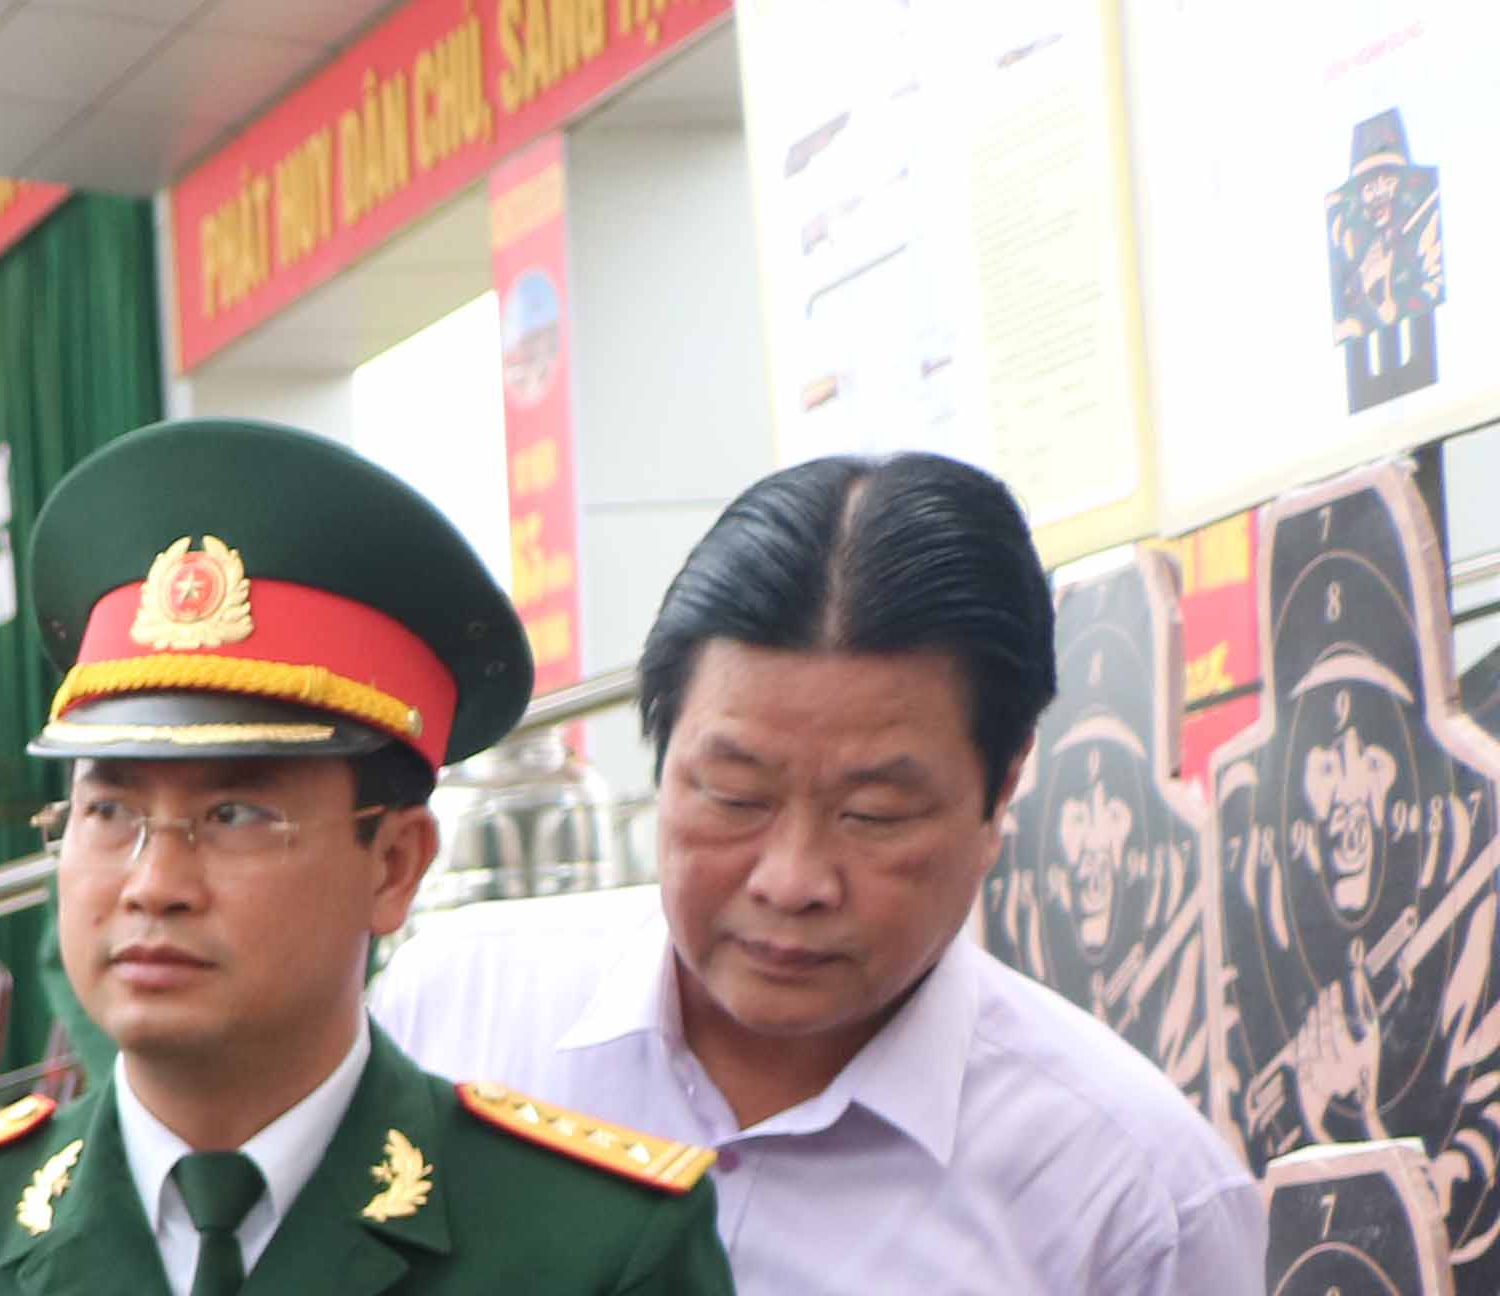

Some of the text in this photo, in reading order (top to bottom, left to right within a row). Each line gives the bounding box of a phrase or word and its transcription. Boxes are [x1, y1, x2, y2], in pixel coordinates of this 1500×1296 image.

[275, 128, 333, 268] HUY
[340, 68, 409, 226] DÂN
[1319, 1193, 1337, 1238] 7
